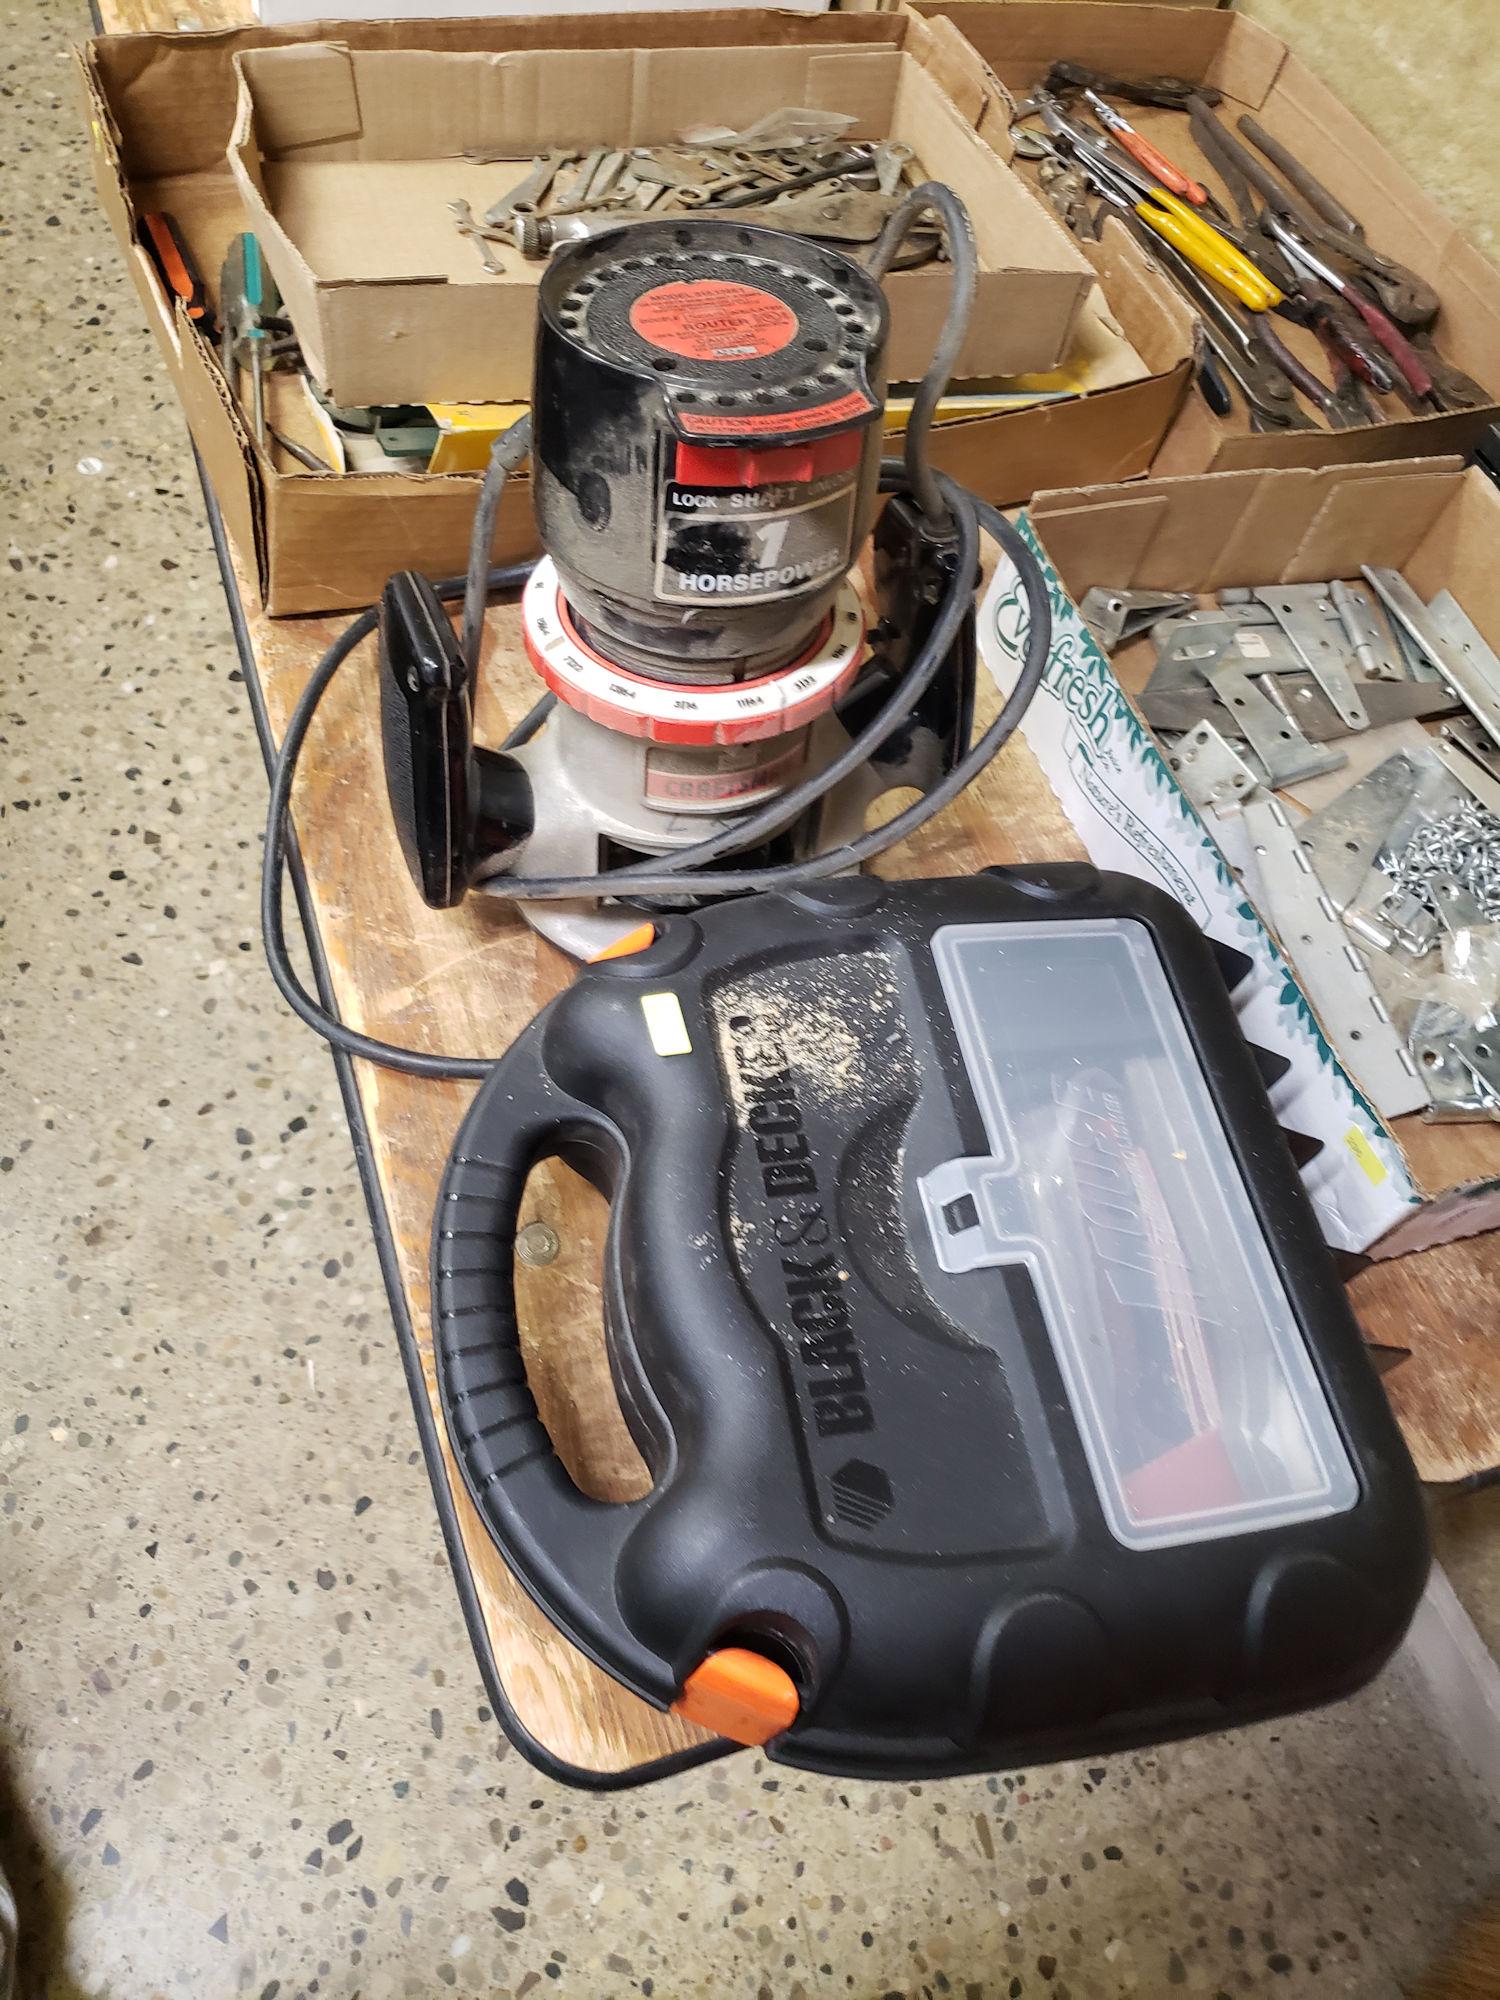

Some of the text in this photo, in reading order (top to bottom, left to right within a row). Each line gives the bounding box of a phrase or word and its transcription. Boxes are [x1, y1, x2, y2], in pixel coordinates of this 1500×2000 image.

[682, 318, 749, 331] ROUTER
[672, 491, 718, 508] LOCK
[730, 486, 798, 508] SHAFT
[755, 519, 790, 570] 1
[678, 549, 841, 593] HORSEPOWER
[673, 700, 700, 712] 3/16
[773, 1204, 832, 1246] &
[780, 1252, 877, 1438] BLACK
